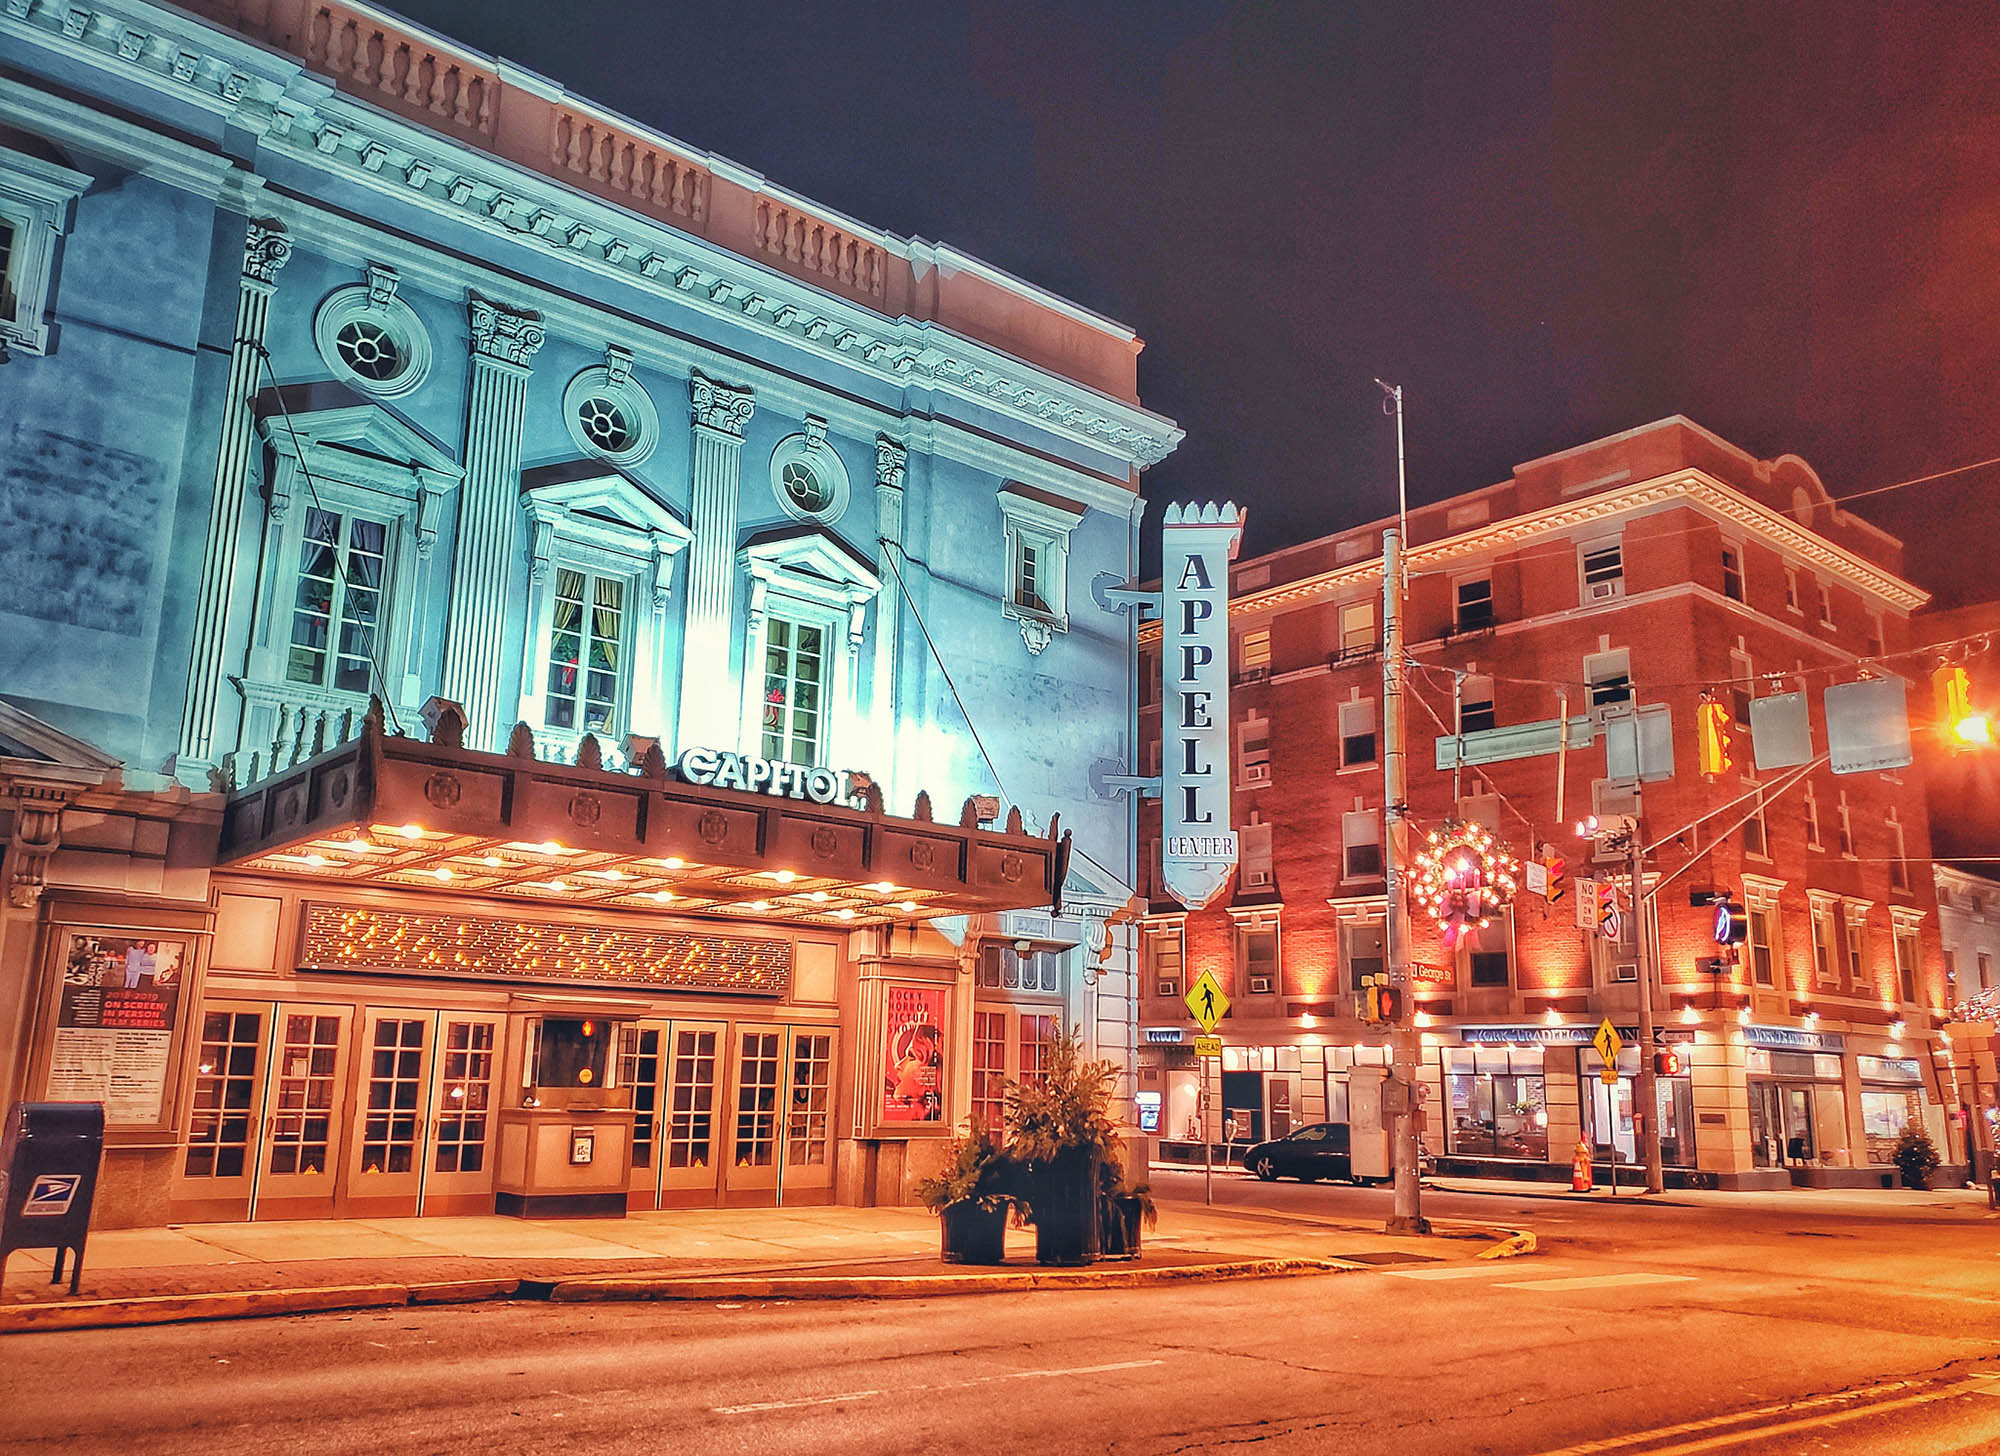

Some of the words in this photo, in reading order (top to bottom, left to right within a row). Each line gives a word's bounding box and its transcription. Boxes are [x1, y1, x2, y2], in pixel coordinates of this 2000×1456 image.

[1176, 554, 1216, 824] APPELL
[682, 746, 867, 812] CAPITOL
[1168, 835, 1234, 857] CENTER
[1582, 884, 1593, 895] NO
[1583, 906, 1592, 915] ON
[1418, 965, 1443, 982] George
[105, 991, 159, 1001] 2018-2019
[889, 991, 923, 1000] ROCKY
[104, 1001, 121, 1009] ON
[888, 1002, 928, 1012] HORROR
[119, 1010, 160, 1018] PERSON
[888, 1013, 929, 1023] PICTURE
[101, 1018, 127, 1026] FILM
[129, 1019, 166, 1027] SERIES
[888, 1024, 917, 1033] SHOW
[1478, 1029, 1508, 1042] YORK
[1512, 1029, 1597, 1042] TRADITIONS
[1617, 1029, 1640, 1041] AN
[1197, 1043, 1220, 1052] AHEAD
